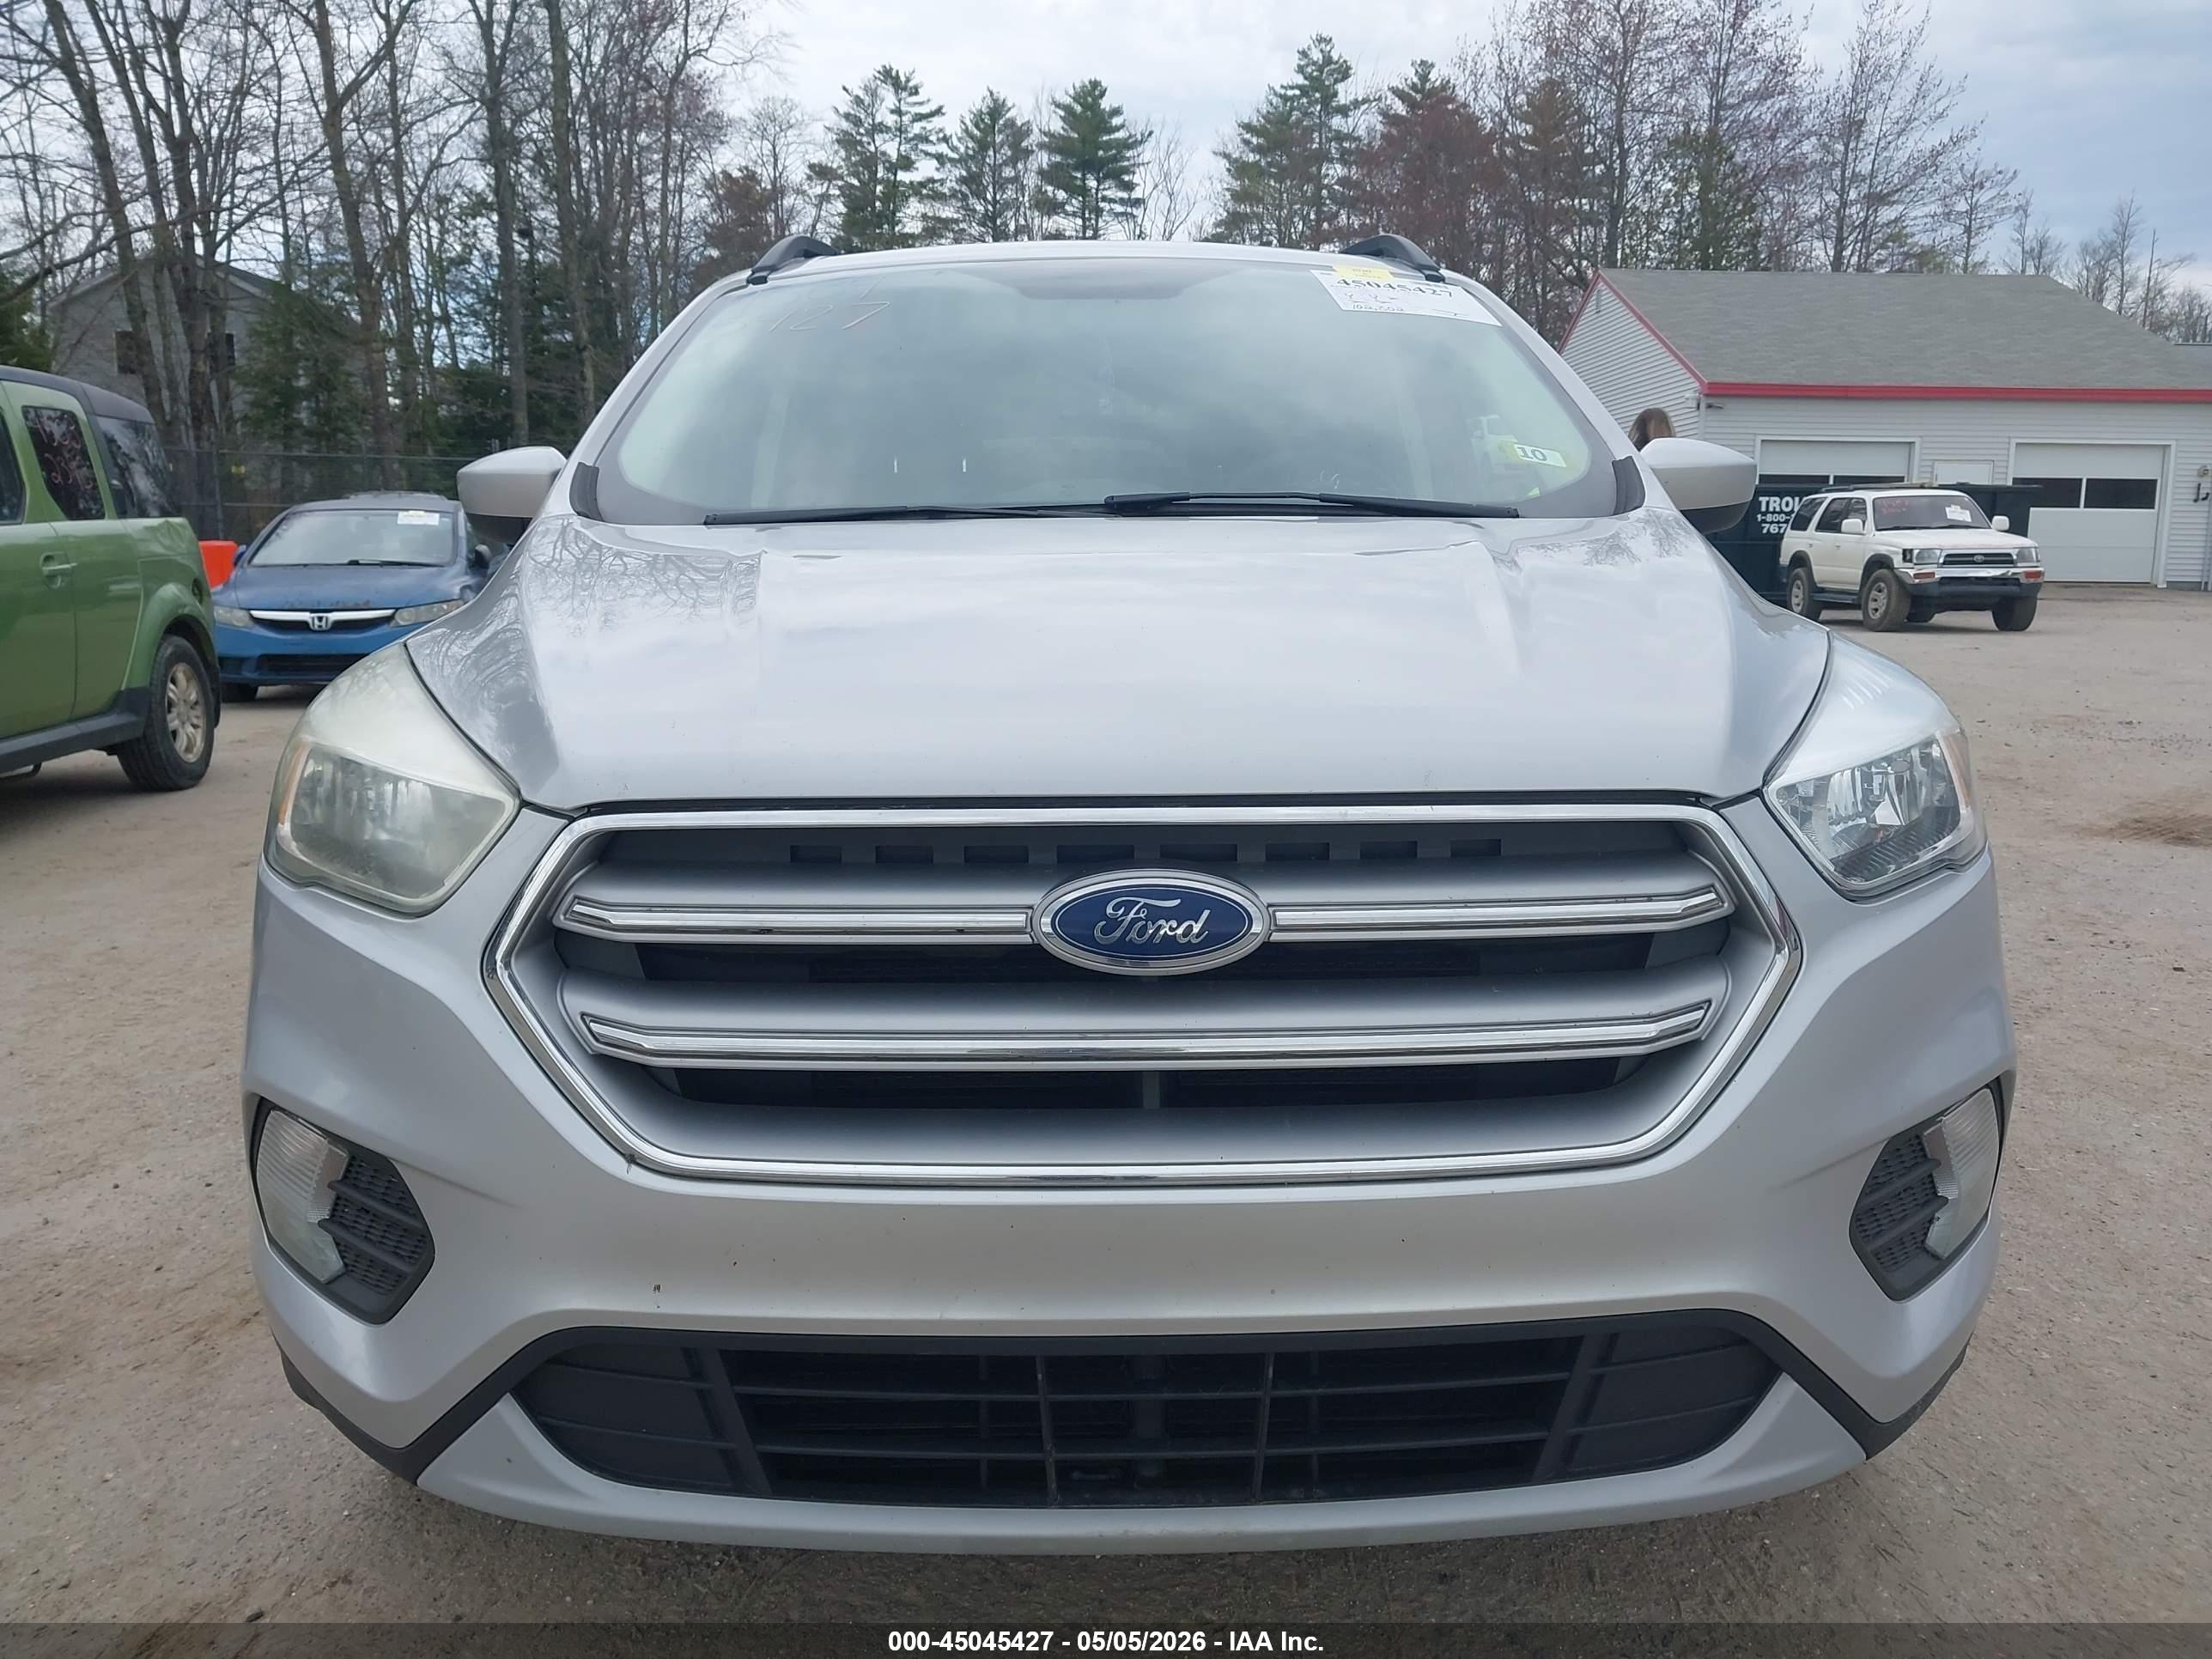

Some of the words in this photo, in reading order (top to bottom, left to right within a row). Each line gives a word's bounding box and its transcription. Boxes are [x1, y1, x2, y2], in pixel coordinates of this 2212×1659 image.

[1337, 277, 1453, 298] 45045427
[1517, 447, 1547, 461] 10
[1760, 523, 1788, 534] 767
[1093, 896, 1211, 945] Ford
